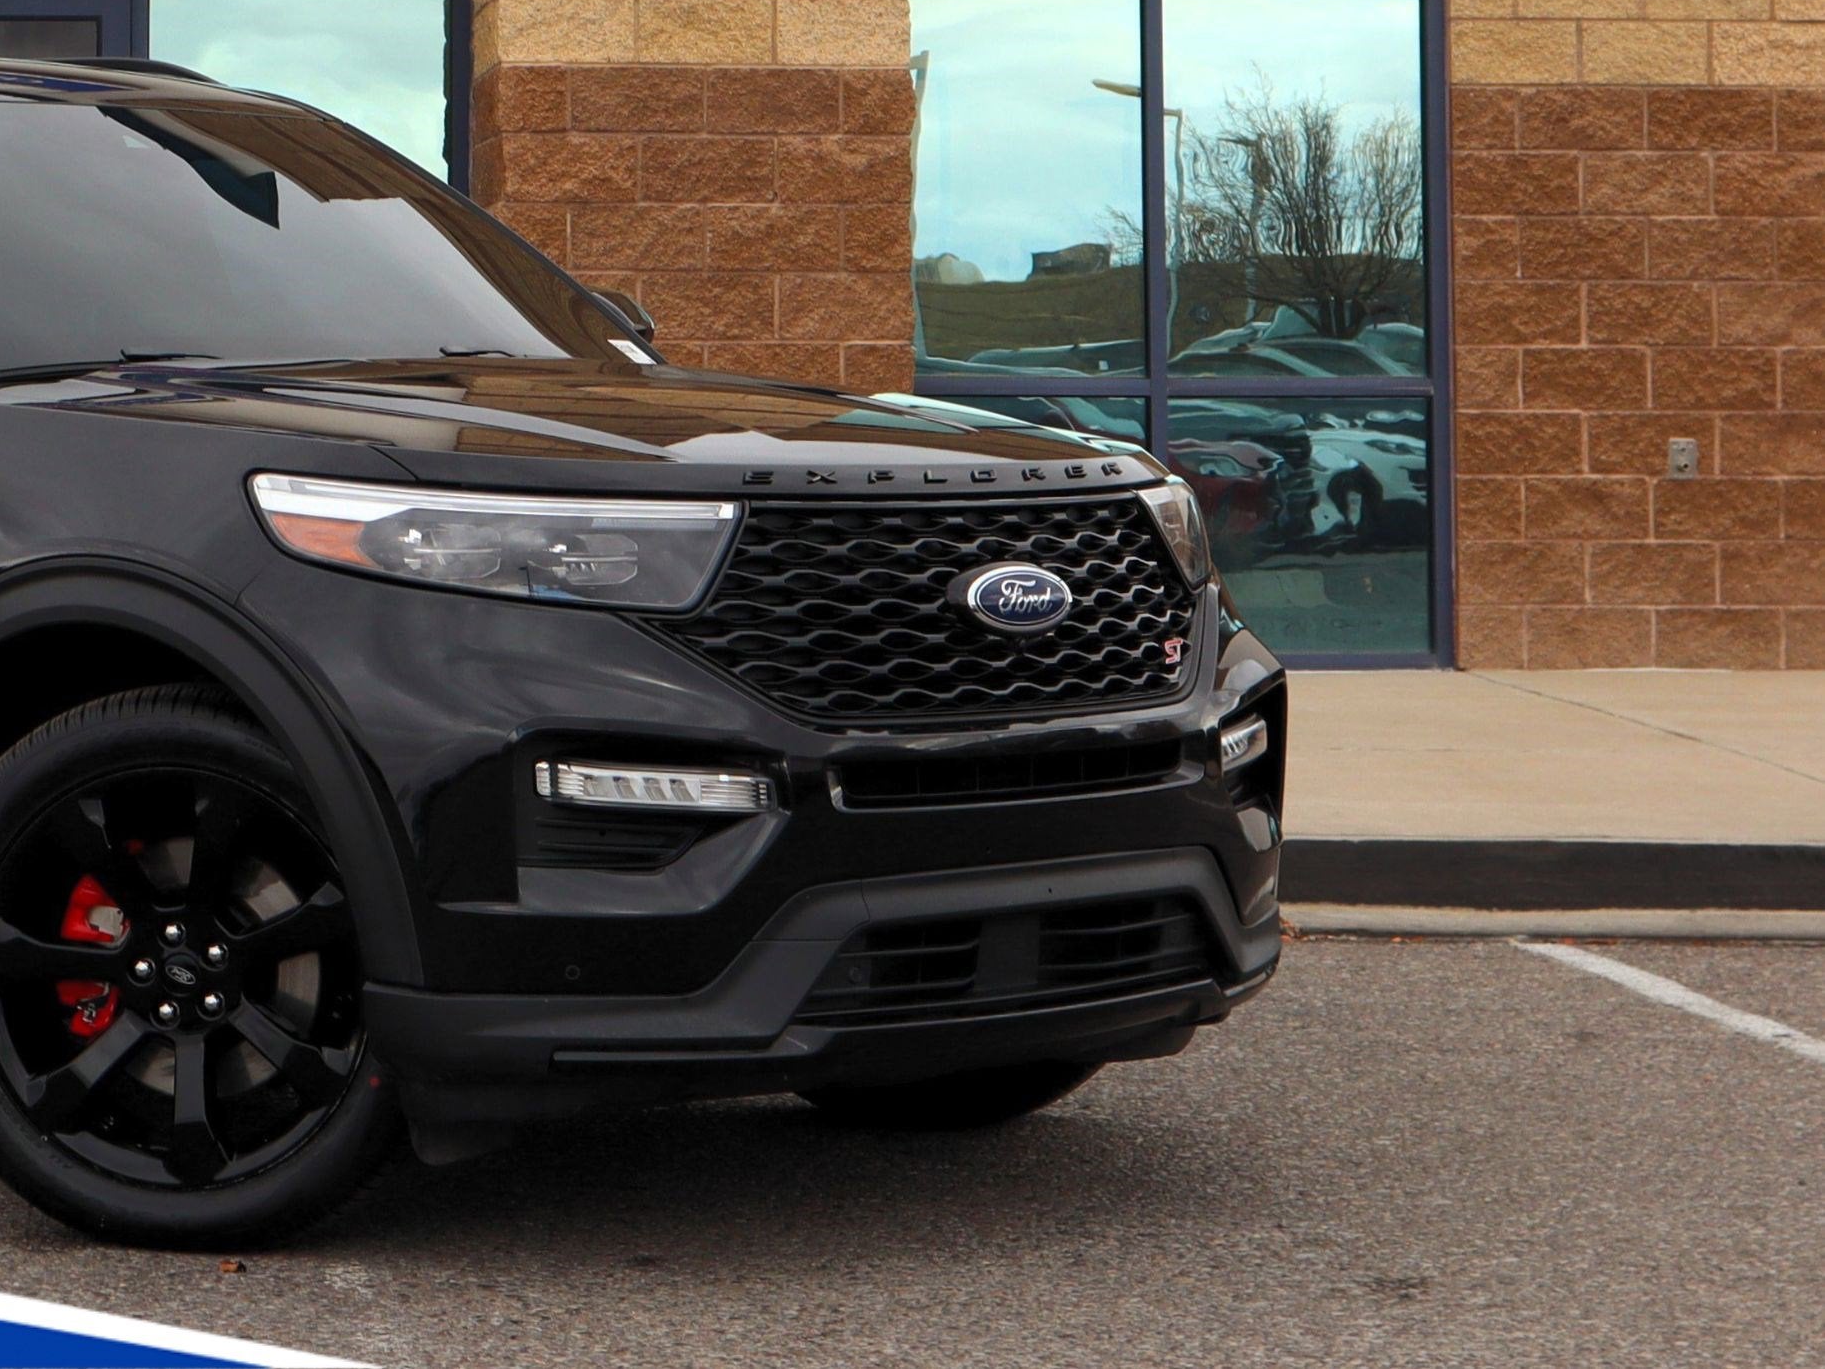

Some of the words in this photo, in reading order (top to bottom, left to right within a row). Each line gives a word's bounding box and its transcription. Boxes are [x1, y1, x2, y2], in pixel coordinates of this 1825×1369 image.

[742, 462, 1124, 486] EXPLORER
[999, 580, 1052, 614] Ford
[1164, 637, 1184, 665] ST
